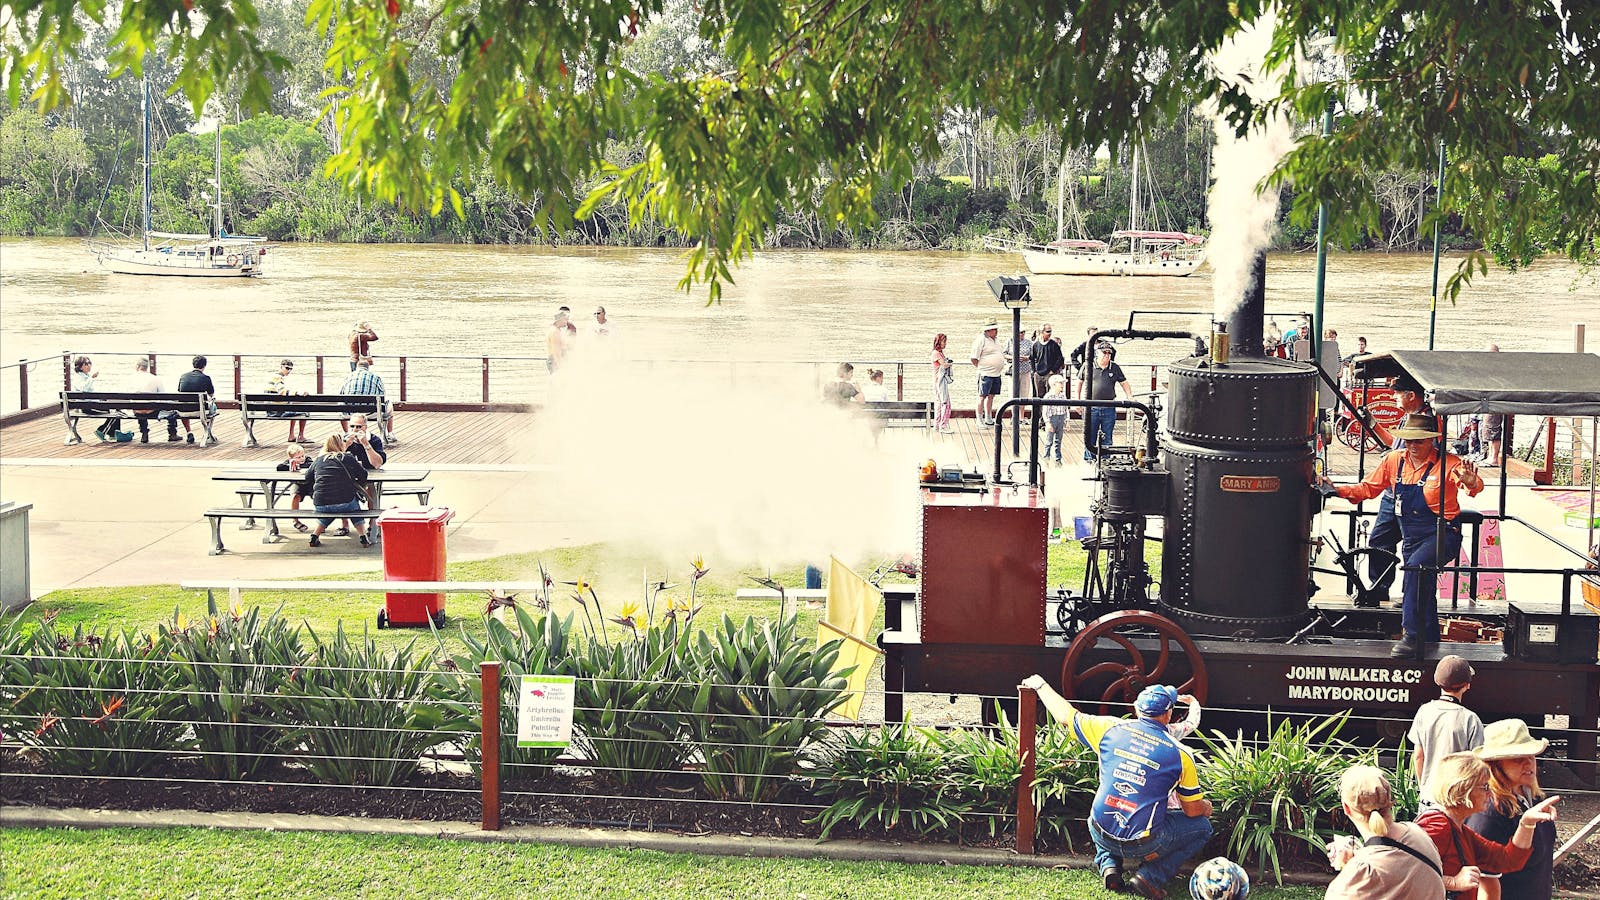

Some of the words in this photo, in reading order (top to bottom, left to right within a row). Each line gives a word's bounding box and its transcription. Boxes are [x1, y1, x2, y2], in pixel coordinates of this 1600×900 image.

[1225, 479, 1252, 489] MARY
[1285, 666, 1326, 680] JOHN
[1328, 666, 1391, 682] WALKER
[1288, 685, 1410, 703] MARYBOROUGH
